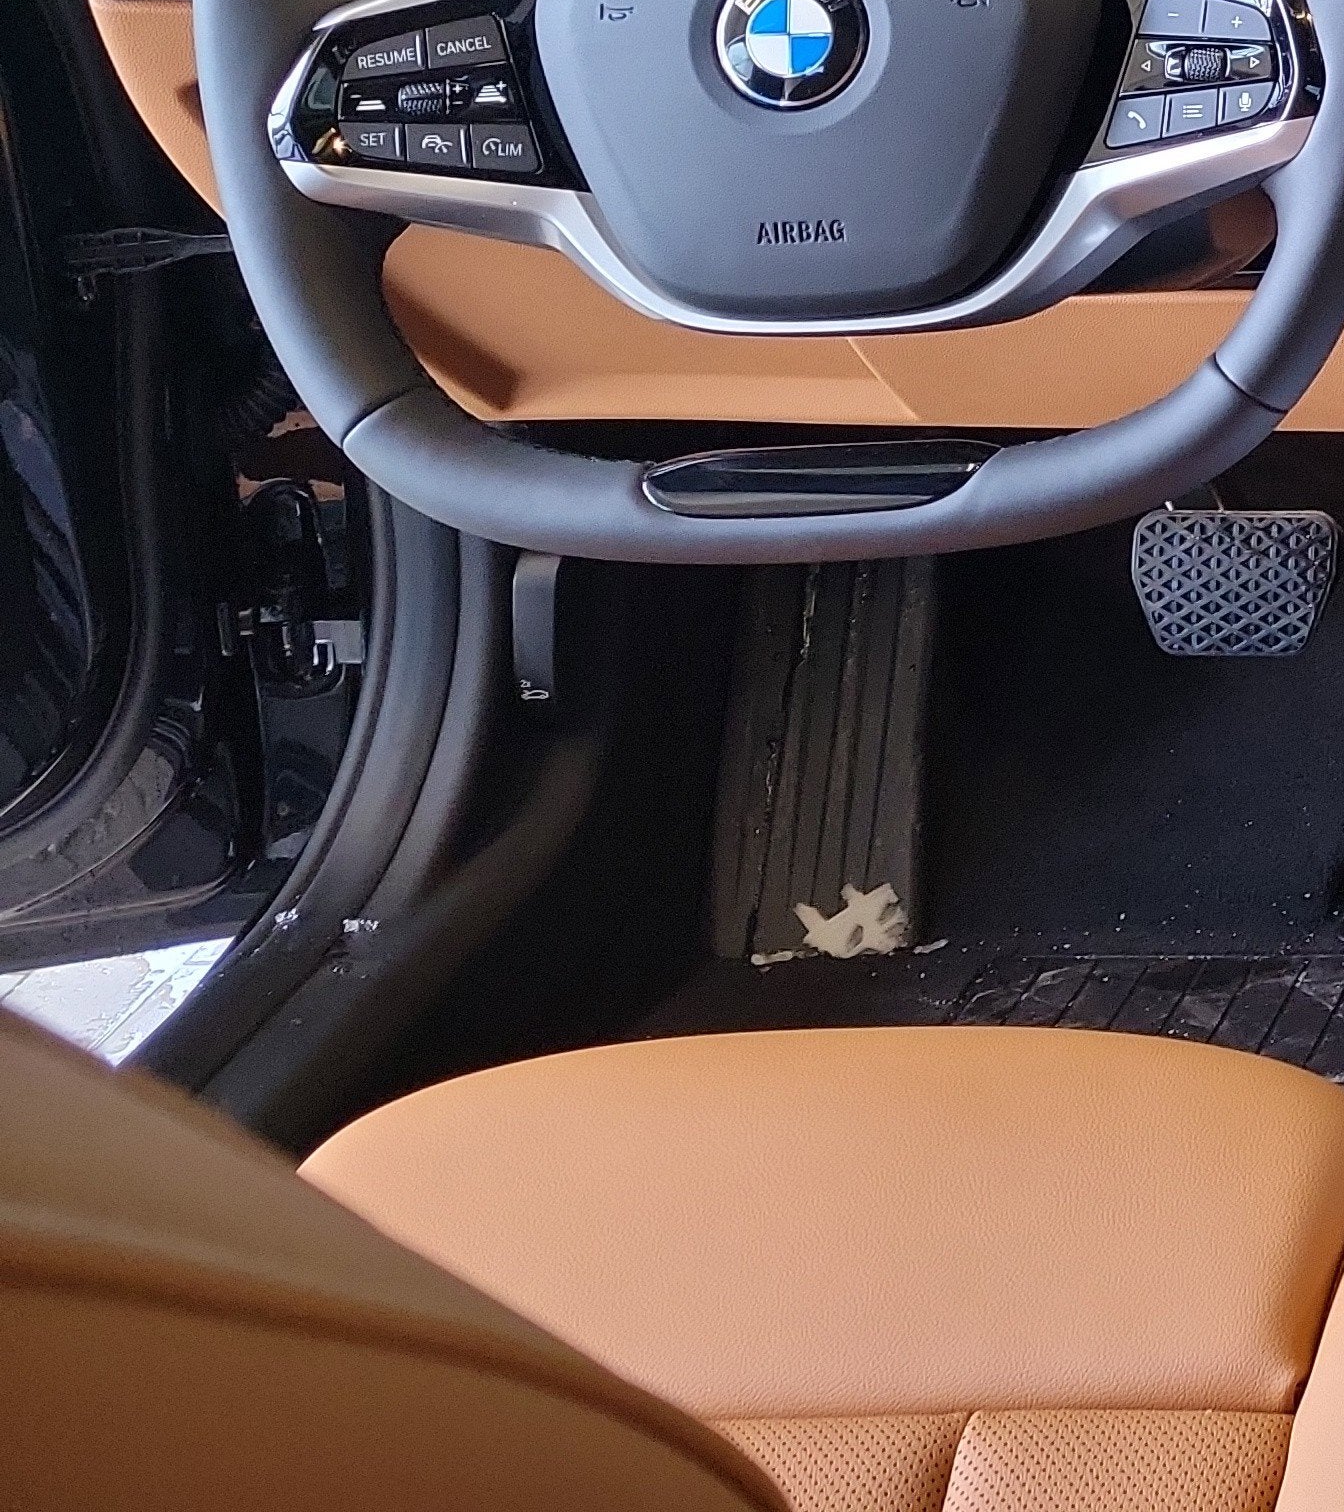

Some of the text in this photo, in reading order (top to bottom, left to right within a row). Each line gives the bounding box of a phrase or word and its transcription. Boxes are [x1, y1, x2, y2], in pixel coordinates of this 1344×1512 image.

[436, 35, 492, 57] CANCEL
[357, 47, 416, 70] RESUME
[360, 132, 387, 147] SET
[498, 144, 523, 157] LIM
[756, 219, 847, 246] AIRBAG
